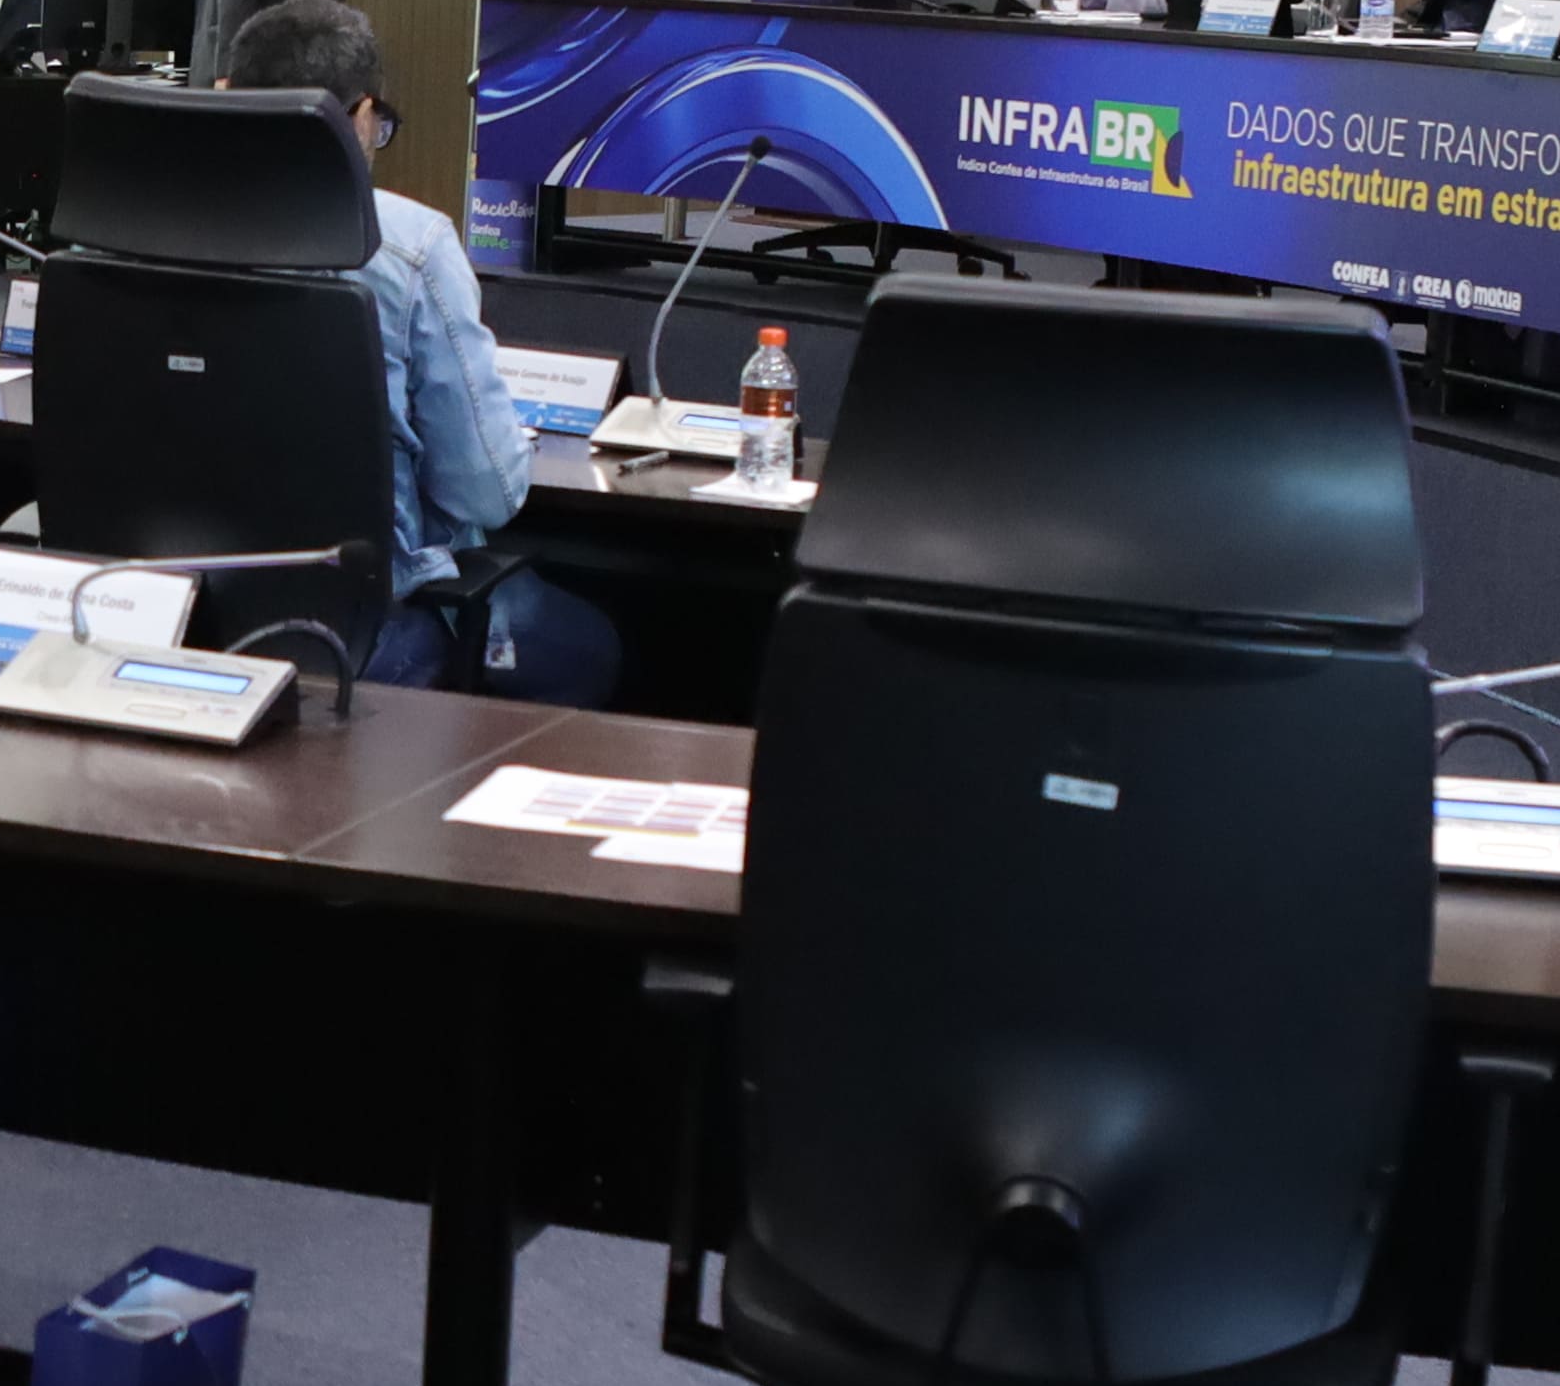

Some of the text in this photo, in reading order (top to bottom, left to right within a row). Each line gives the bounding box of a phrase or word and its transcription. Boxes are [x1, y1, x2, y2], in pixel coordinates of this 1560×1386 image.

[1227, 102, 1335, 149] DADOS
[1343, 113, 1408, 158] QUE
[1024, 166, 1037, 179] de
[1038, 169, 1104, 188] Infraestrutura
[1105, 176, 1120, 189] do
[1121, 178, 1149, 193] Brasil
[1233, 150, 1429, 212] infraestrutura
[1437, 183, 1482, 219] em
[1332, 260, 1389, 288] CONFEA
[1413, 275, 1452, 299] CREA
